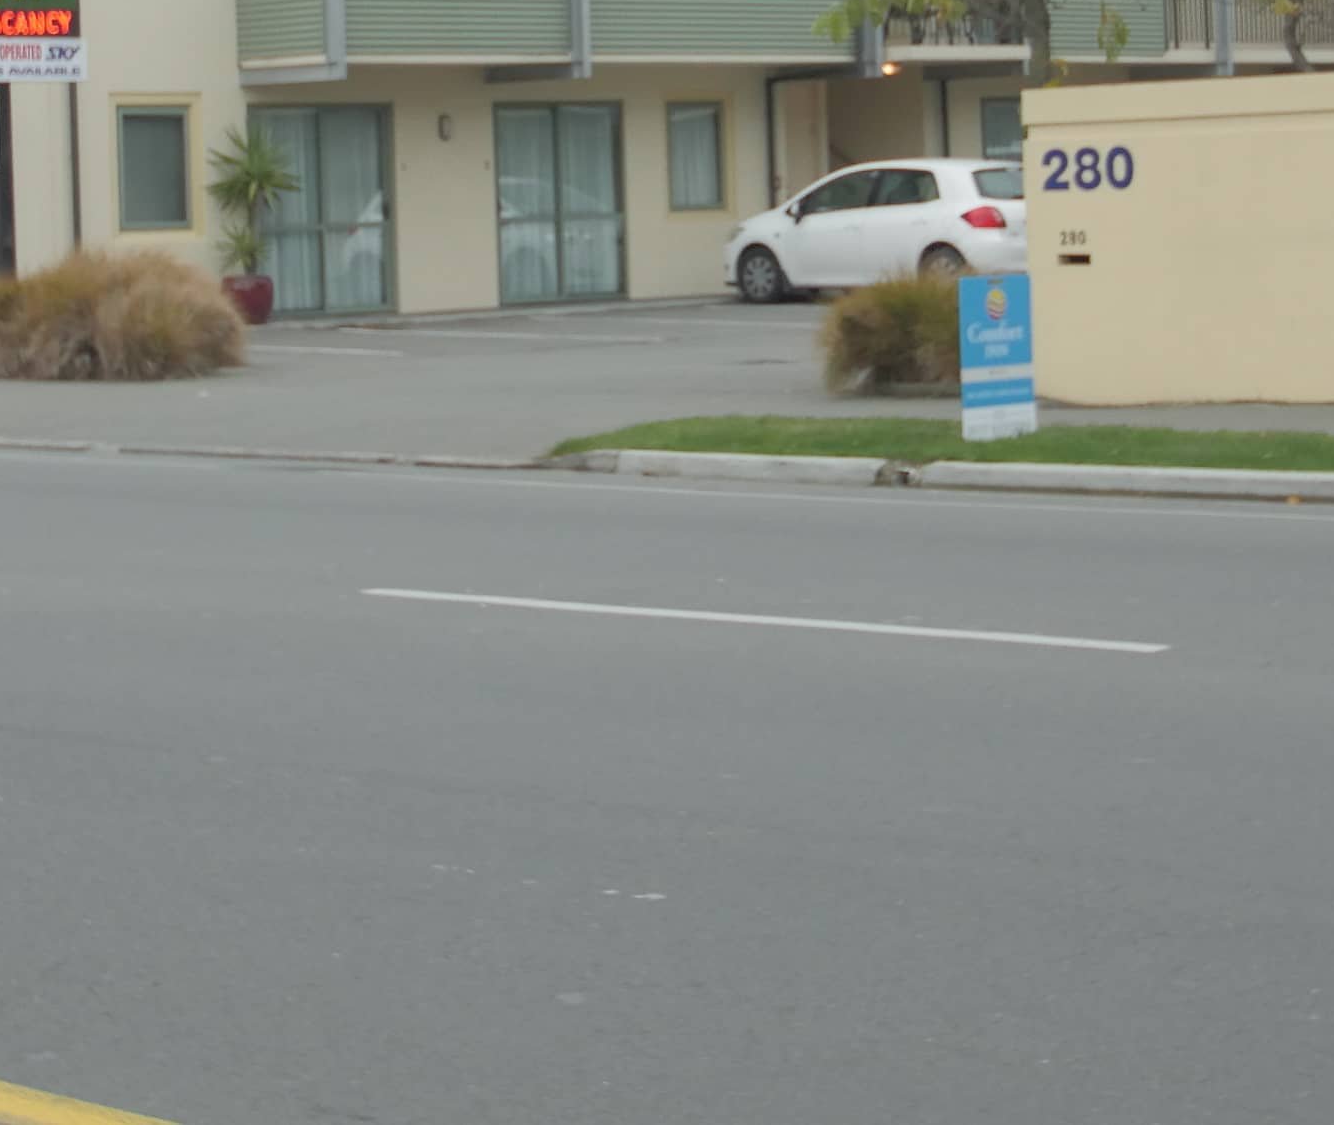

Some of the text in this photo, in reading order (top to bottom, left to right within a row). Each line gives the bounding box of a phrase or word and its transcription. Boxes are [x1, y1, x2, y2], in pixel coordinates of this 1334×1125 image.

[0, 44, 42, 61] OPERATED
[9, 65, 80, 75] AVAILABLE
[1041, 146, 1134, 191] 280
[1059, 230, 1087, 246] 280
